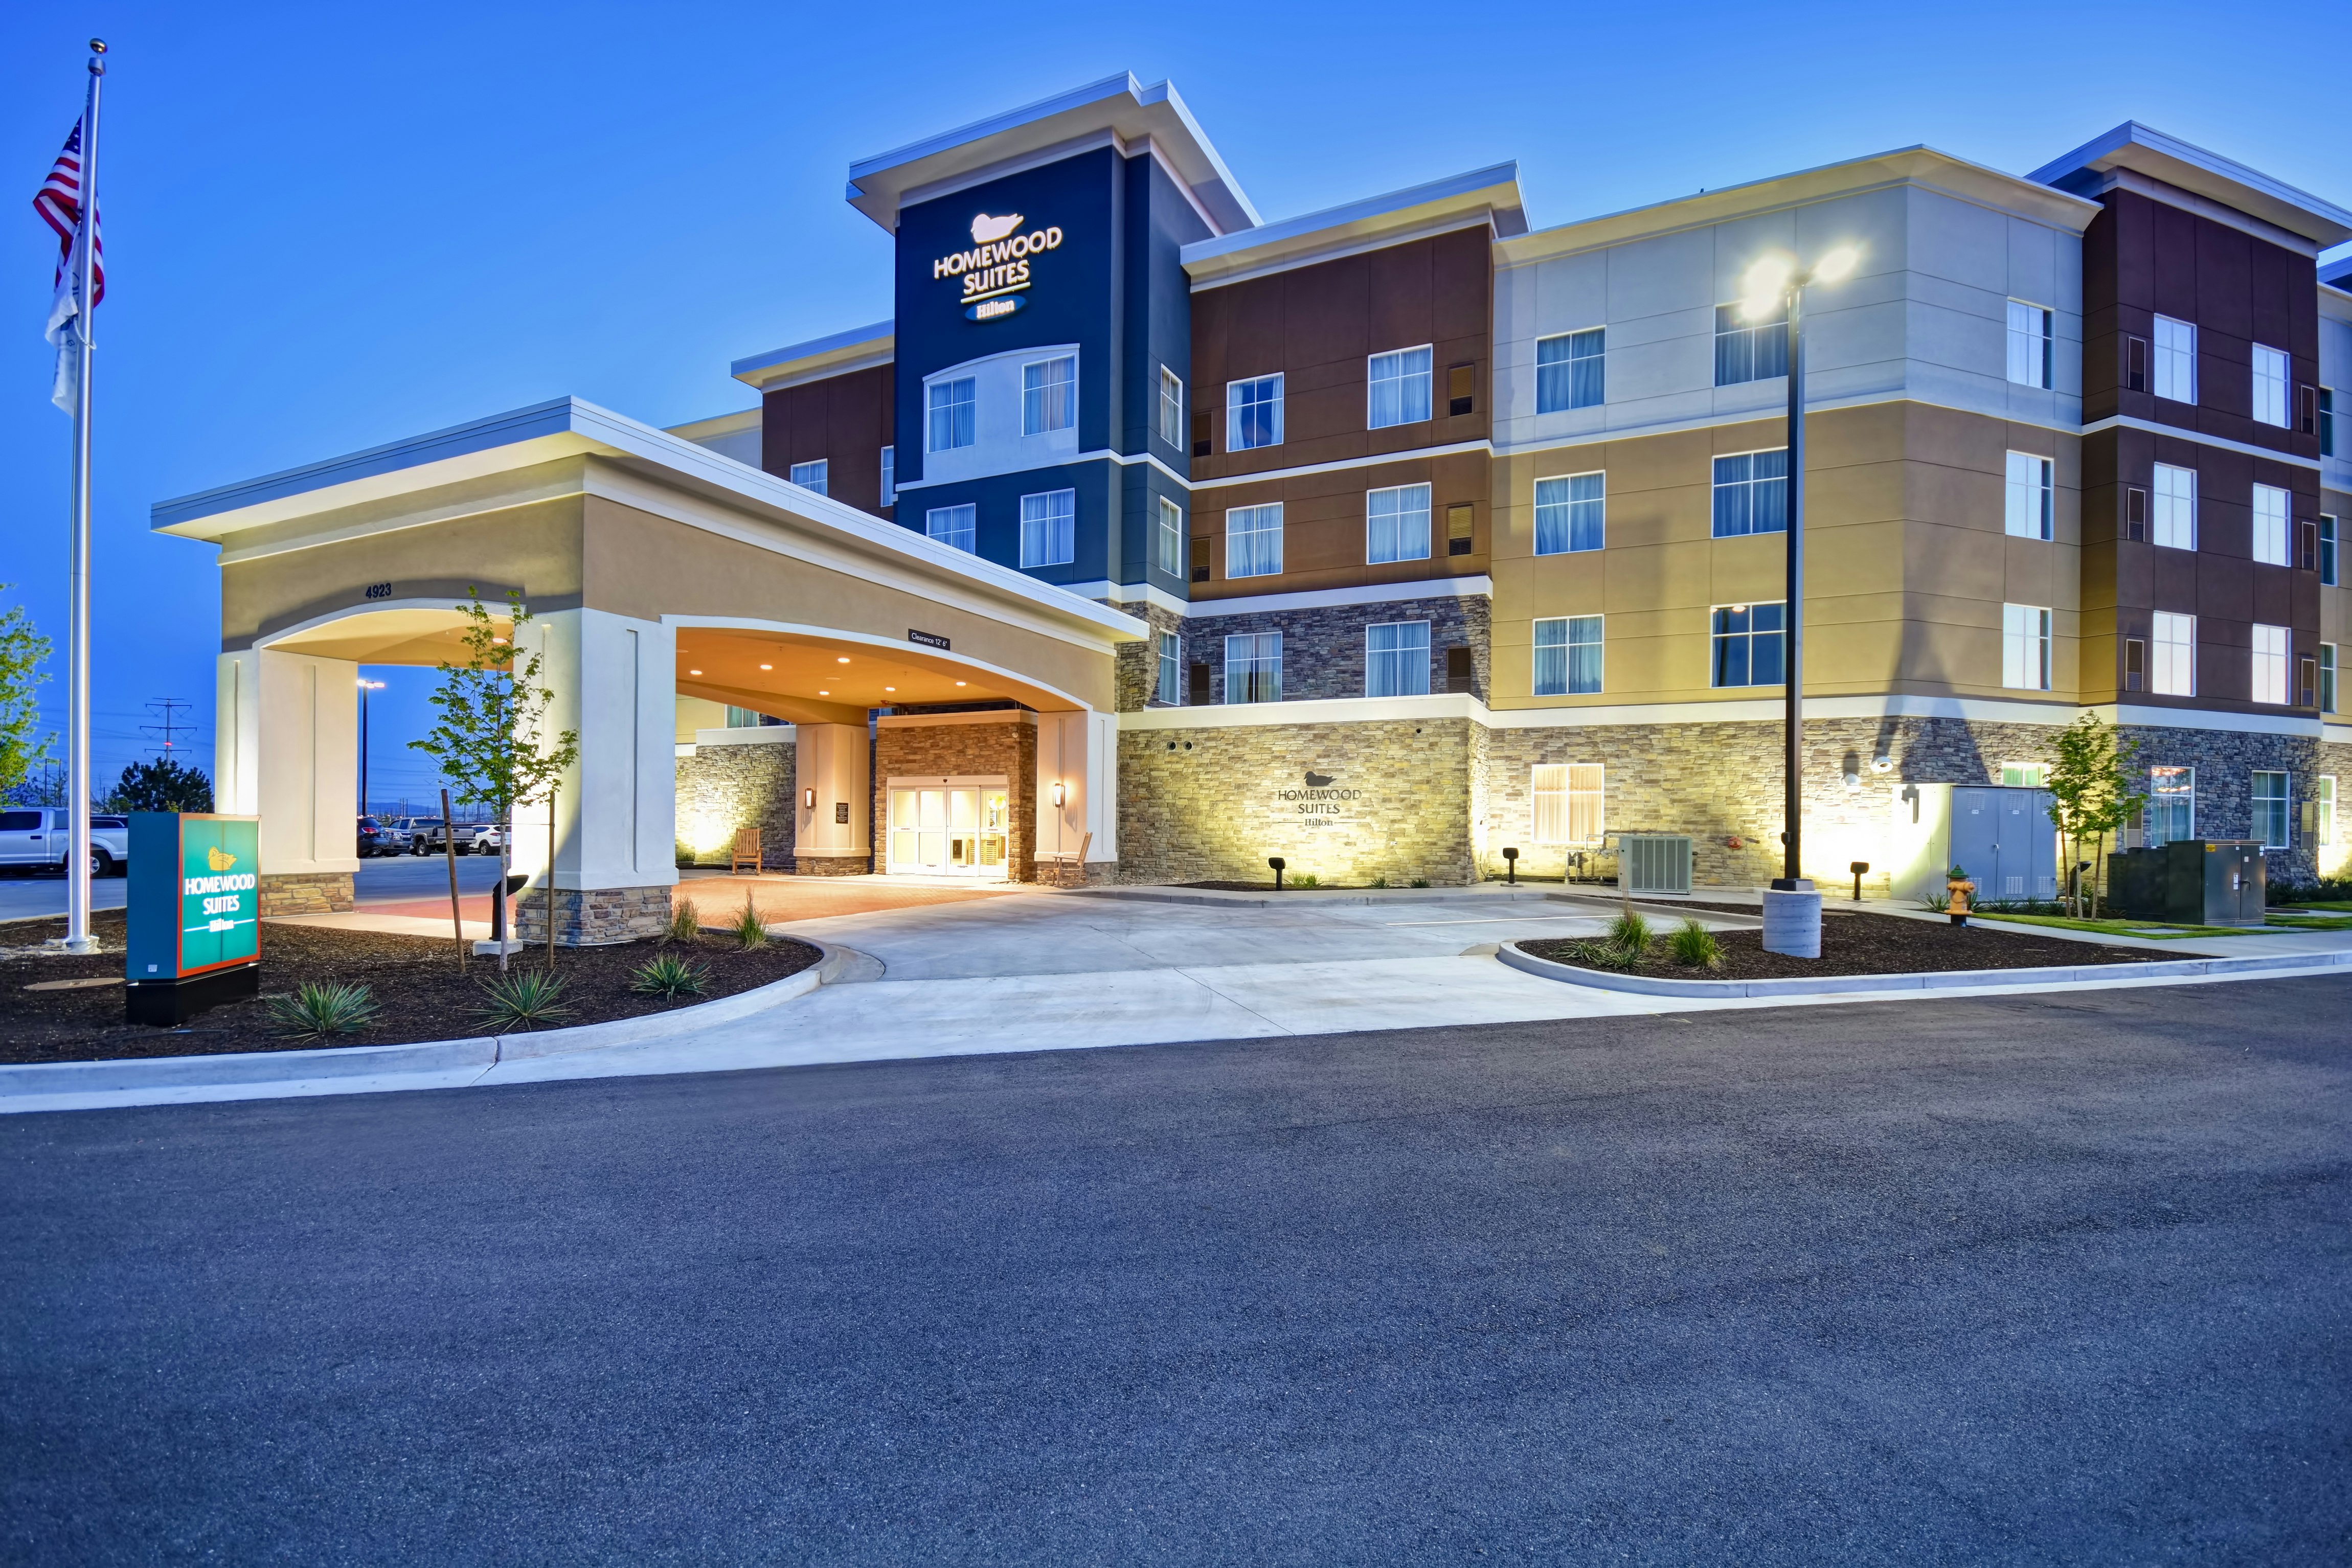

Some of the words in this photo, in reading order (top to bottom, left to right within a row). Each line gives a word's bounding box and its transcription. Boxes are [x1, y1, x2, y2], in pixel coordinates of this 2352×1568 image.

[934, 226, 1062, 279] HOMEWOOD
[963, 259, 1029, 294] SUITES
[976, 300, 1014, 319] Hilton
[366, 583, 391, 599] 4923
[912, 633, 934, 644] Clearance
[1278, 789, 1362, 801] HOMEWOOD
[1298, 803, 1340, 814] SUITES
[1304, 818, 1333, 826] Hilton
[185, 874, 255, 895] HOMEWOOD
[202, 895, 240, 915] SUITES
